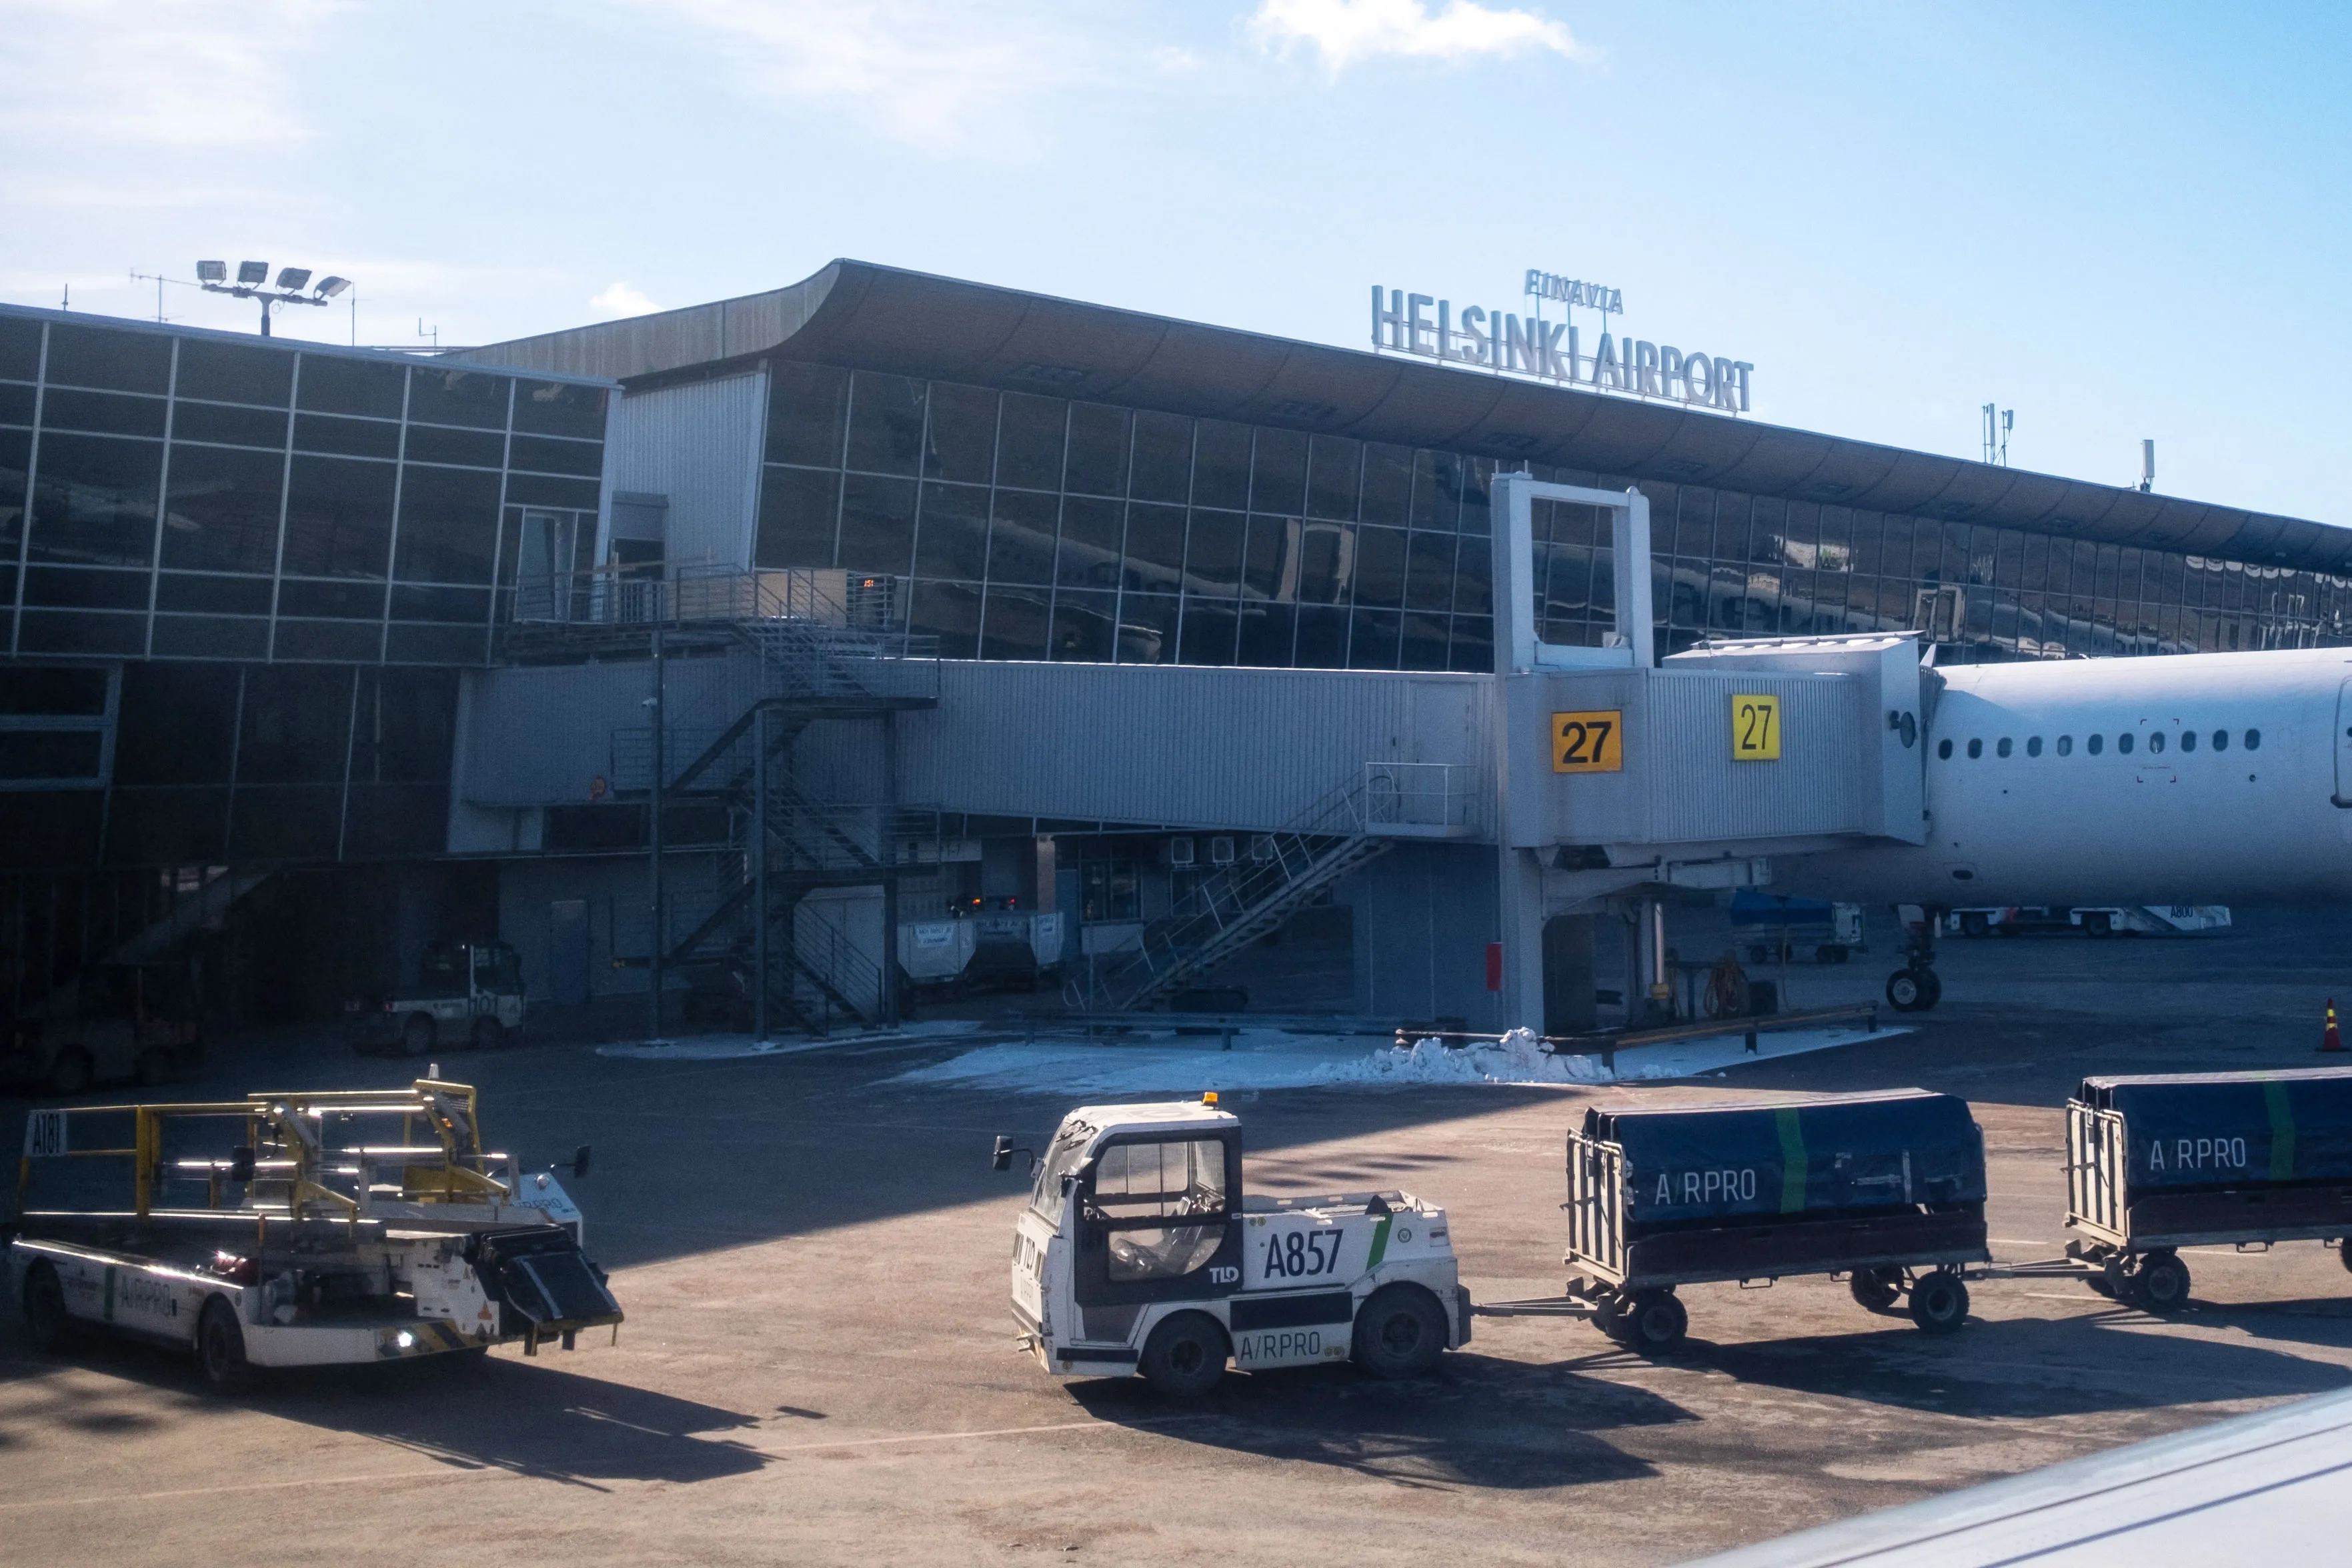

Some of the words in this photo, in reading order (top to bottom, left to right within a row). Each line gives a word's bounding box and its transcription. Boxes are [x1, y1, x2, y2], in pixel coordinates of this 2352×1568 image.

[1524, 269, 1623, 314] FINAVIA
[1372, 285, 1579, 380] HELSINKI
[1592, 333, 1754, 411] AIRPORT
[1562, 721, 1612, 763] 27
[1740, 704, 1772, 750] 27
[33, 1113, 59, 1154] A181
[1210, 1267, 1239, 1284] TLD
[1264, 1228, 1344, 1279] A857
